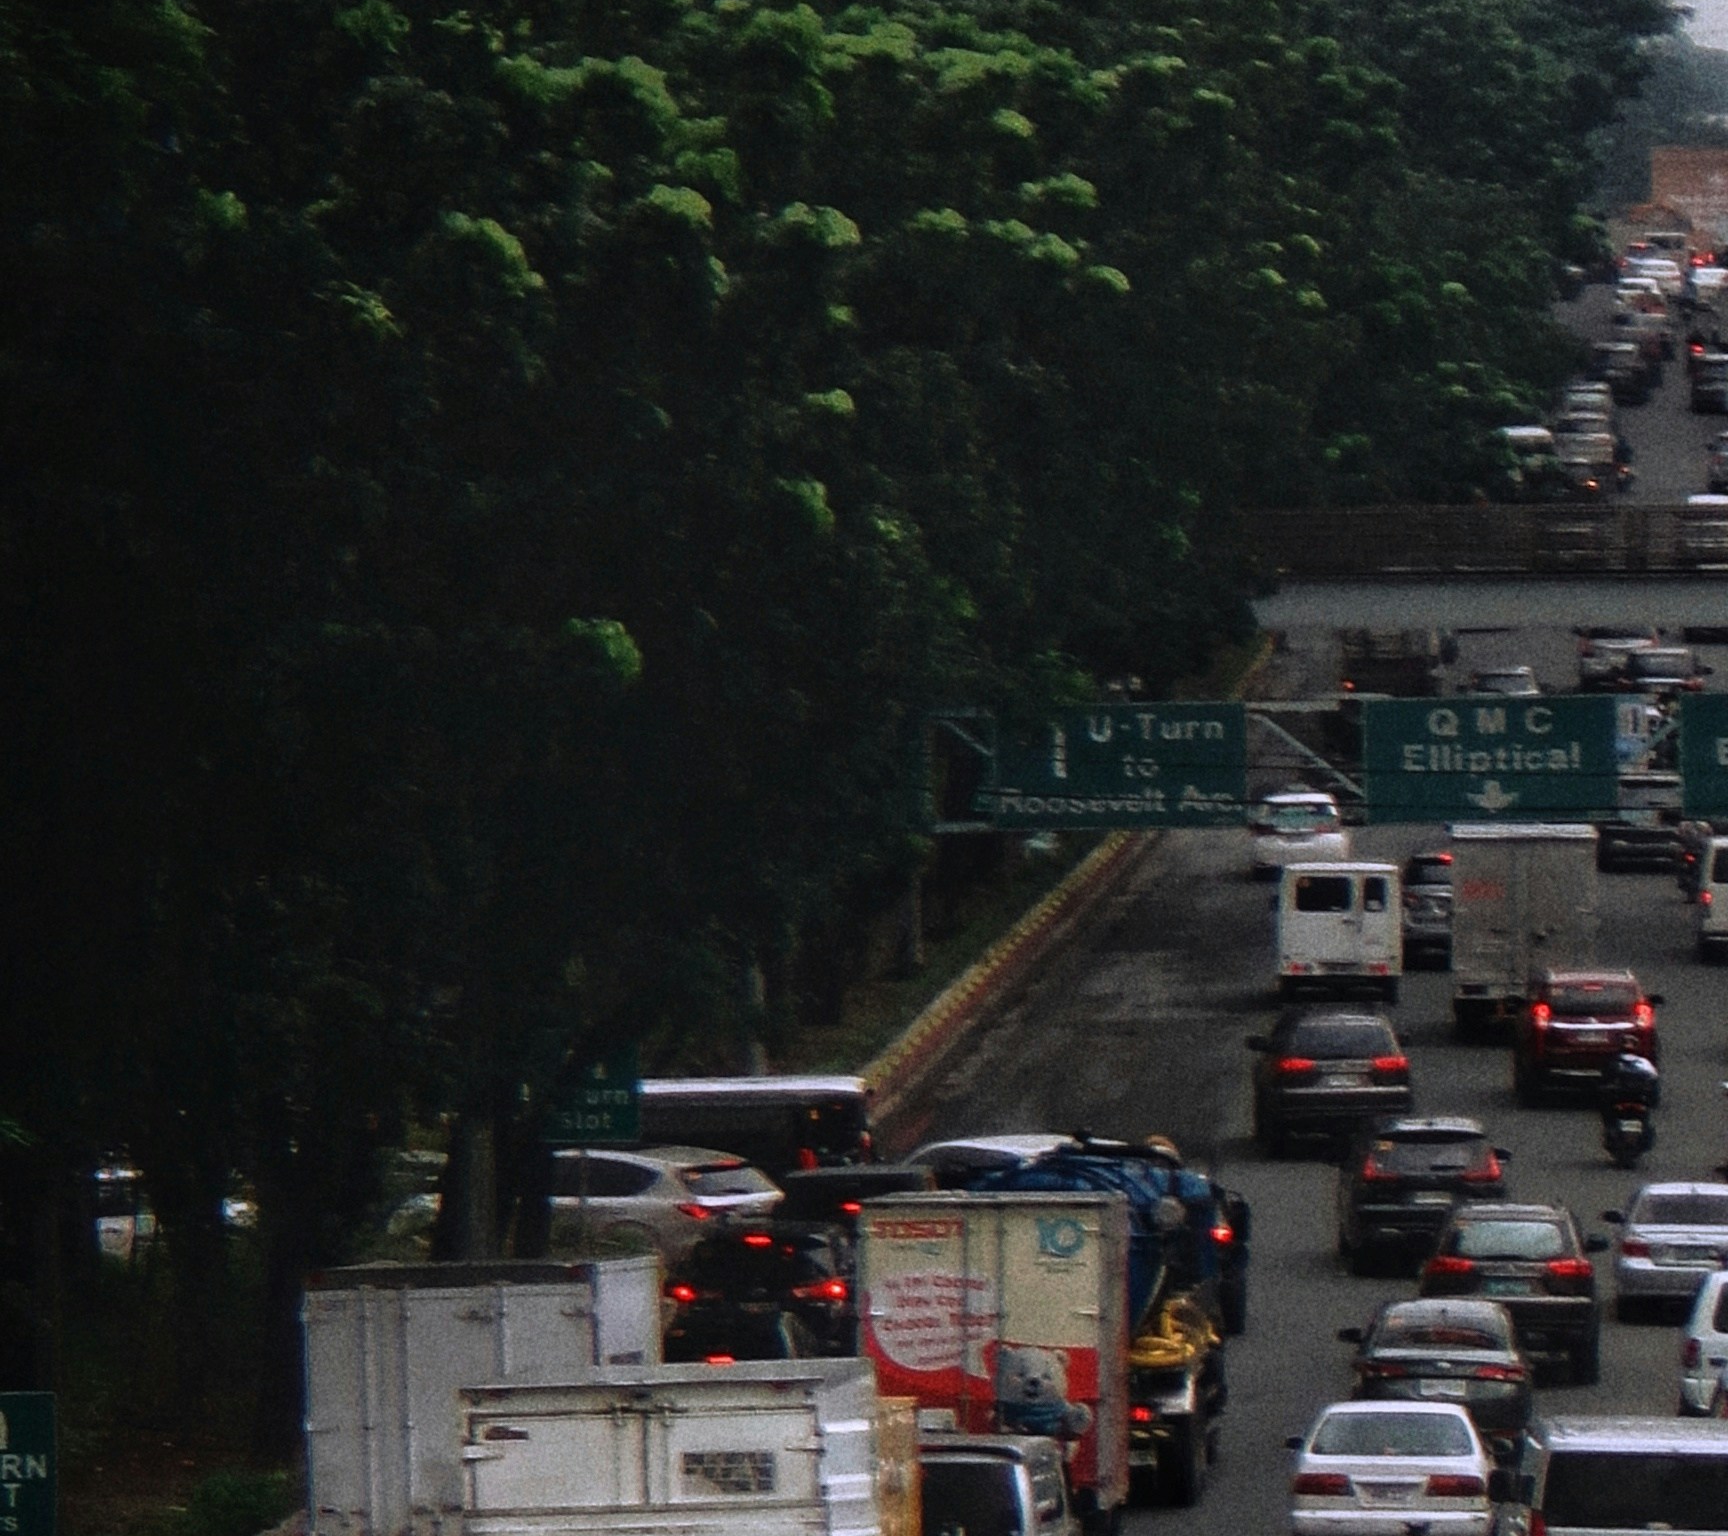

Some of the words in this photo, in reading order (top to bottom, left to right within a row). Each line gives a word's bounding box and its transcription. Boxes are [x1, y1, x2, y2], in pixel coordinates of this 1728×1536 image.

[1087, 713, 1225, 743] U-Turn
[1121, 754, 1160, 778] to
[1402, 740, 1582, 777] Elliptical
